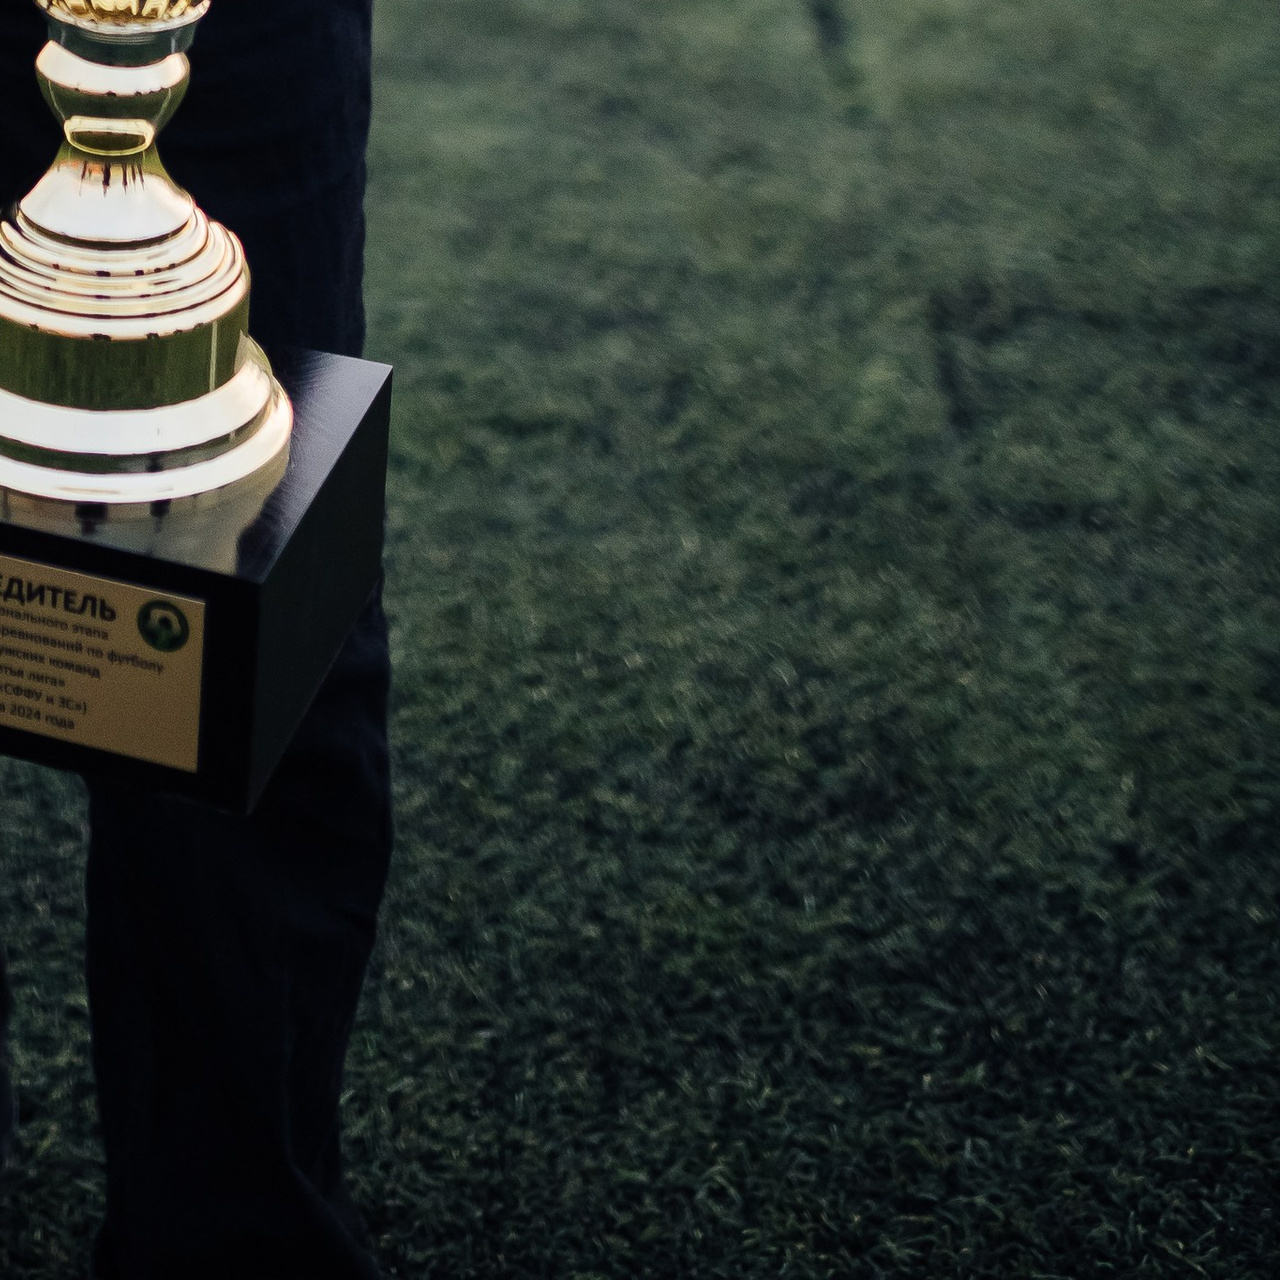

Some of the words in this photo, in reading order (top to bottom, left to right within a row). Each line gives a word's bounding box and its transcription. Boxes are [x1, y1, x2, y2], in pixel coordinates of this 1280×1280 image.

[71, 622, 109, 640] этапа
[49, 657, 101, 680] команд
[86, 645, 104, 659] по
[107, 649, 165, 675] футболу
[29, 672, 66, 687] лига»
[46, 694, 55, 706] и
[9, 702, 42, 722] 2024
[45, 714, 75, 730] года
